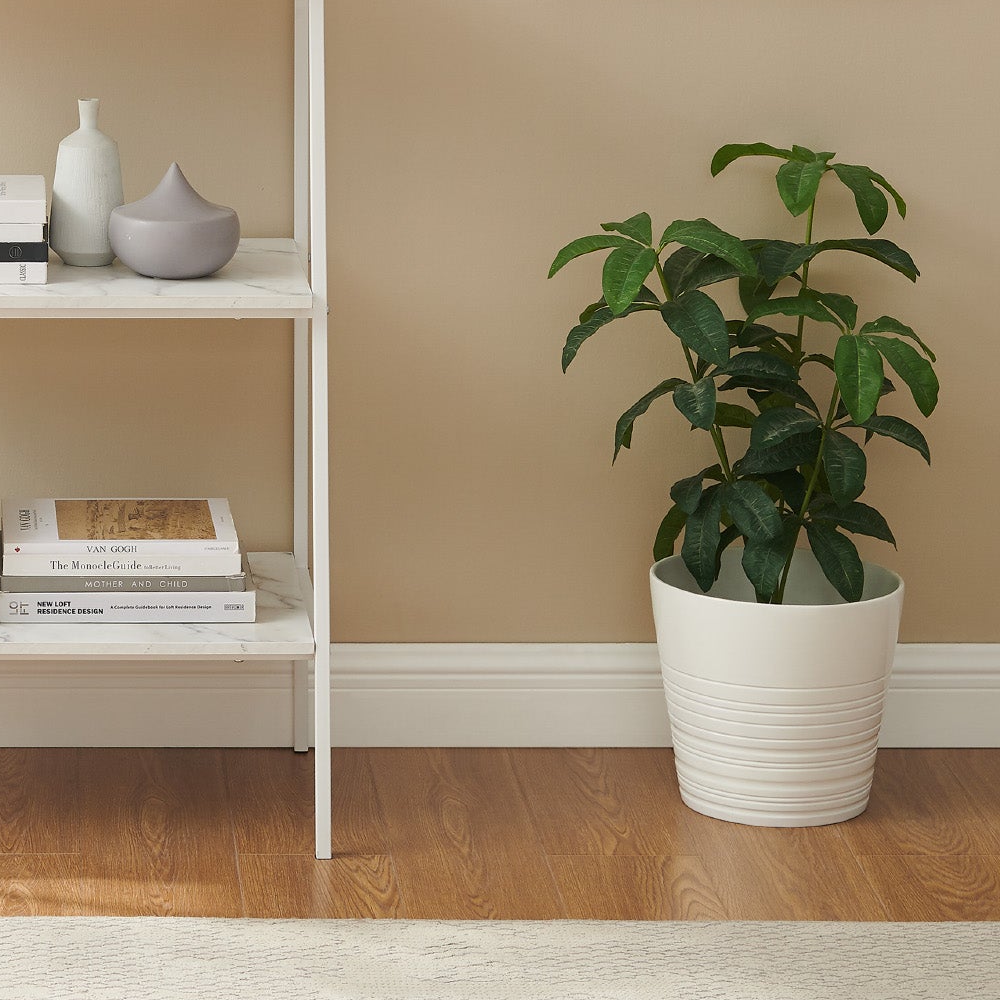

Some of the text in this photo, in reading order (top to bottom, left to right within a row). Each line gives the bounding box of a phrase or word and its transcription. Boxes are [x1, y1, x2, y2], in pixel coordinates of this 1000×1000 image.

[86, 545, 137, 553] VAN GOGH
[50, 560, 69, 570] The
[71, 560, 142, 570] MonocleGuide
[85, 580, 188, 588] MOTHER AND CHILD
